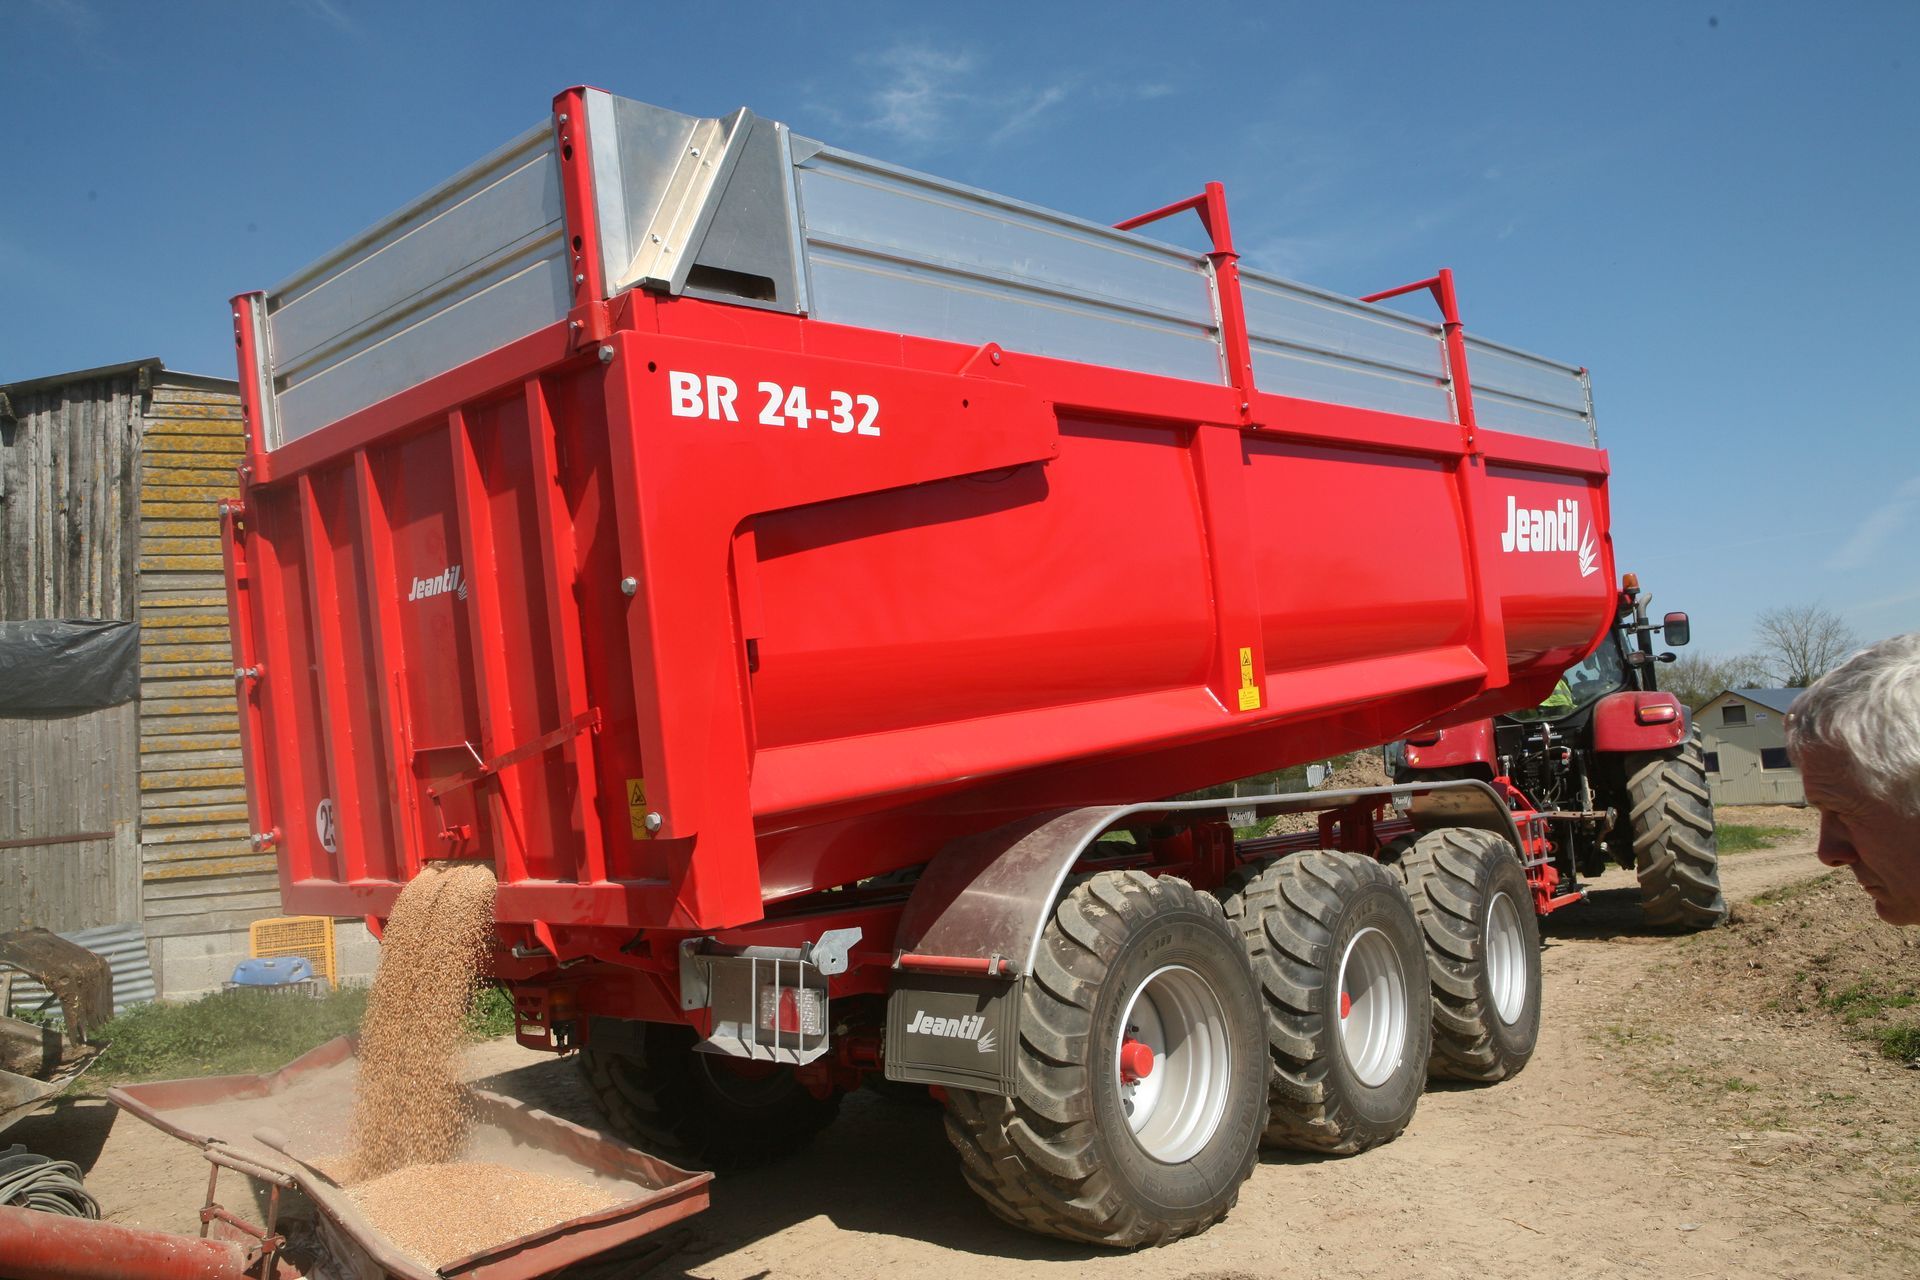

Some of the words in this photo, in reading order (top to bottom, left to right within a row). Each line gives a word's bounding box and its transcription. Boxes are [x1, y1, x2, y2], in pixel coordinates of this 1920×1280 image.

[669, 370, 739, 422] BR
[758, 381, 880, 436] 24-32
[1501, 495, 1578, 552] Jeantil
[408, 565, 460, 602] Jeantil
[906, 1009, 986, 1041] Jeantil
